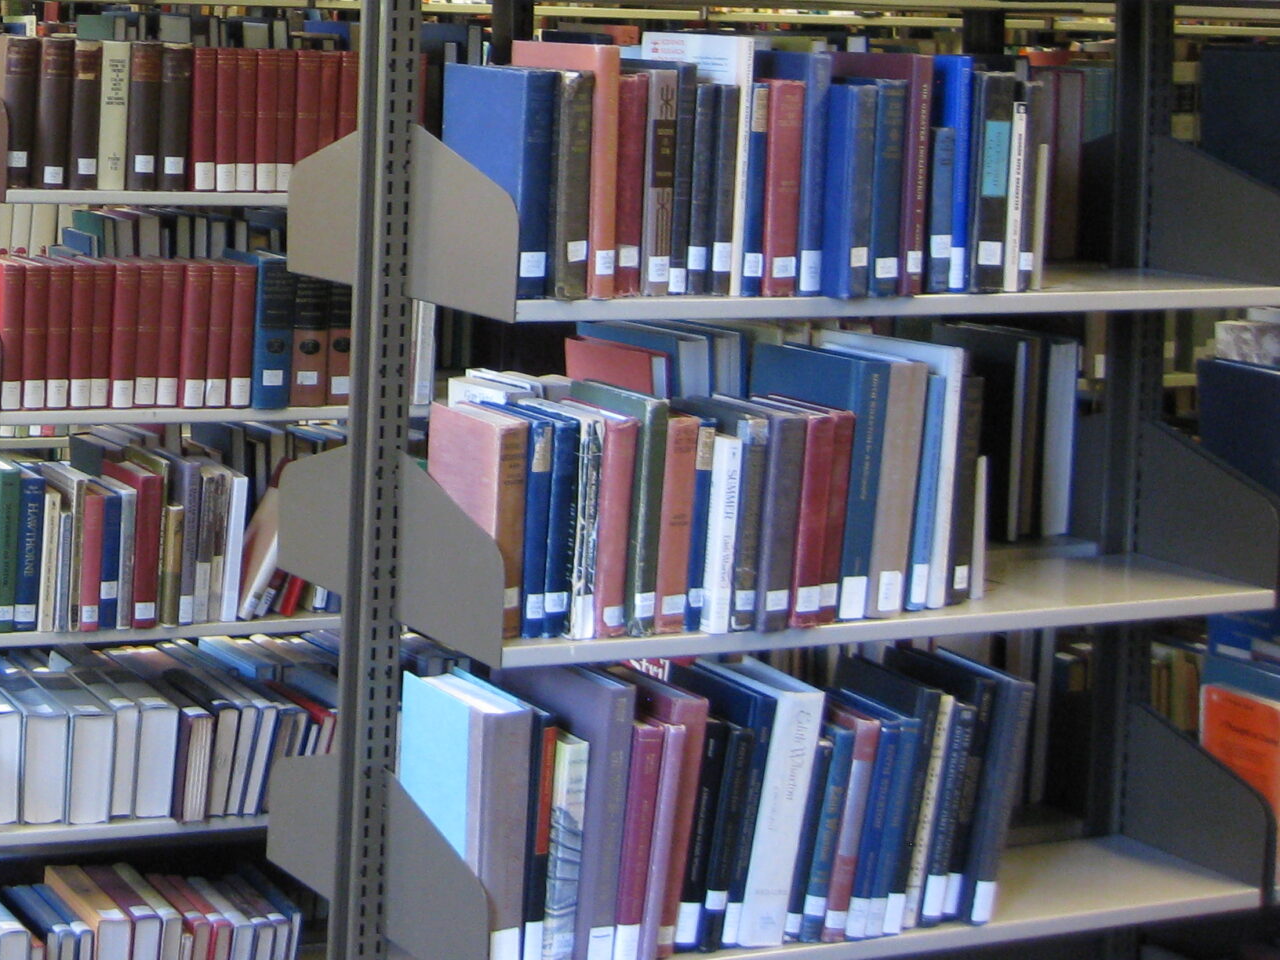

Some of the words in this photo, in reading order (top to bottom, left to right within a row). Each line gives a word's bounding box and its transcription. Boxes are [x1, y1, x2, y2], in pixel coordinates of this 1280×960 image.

[724, 469, 737, 520] SUMMER
[24, 503, 39, 576] HAWTHORNE
[794, 710, 812, 743] Edith
[785, 747, 806, 800] Wharton
